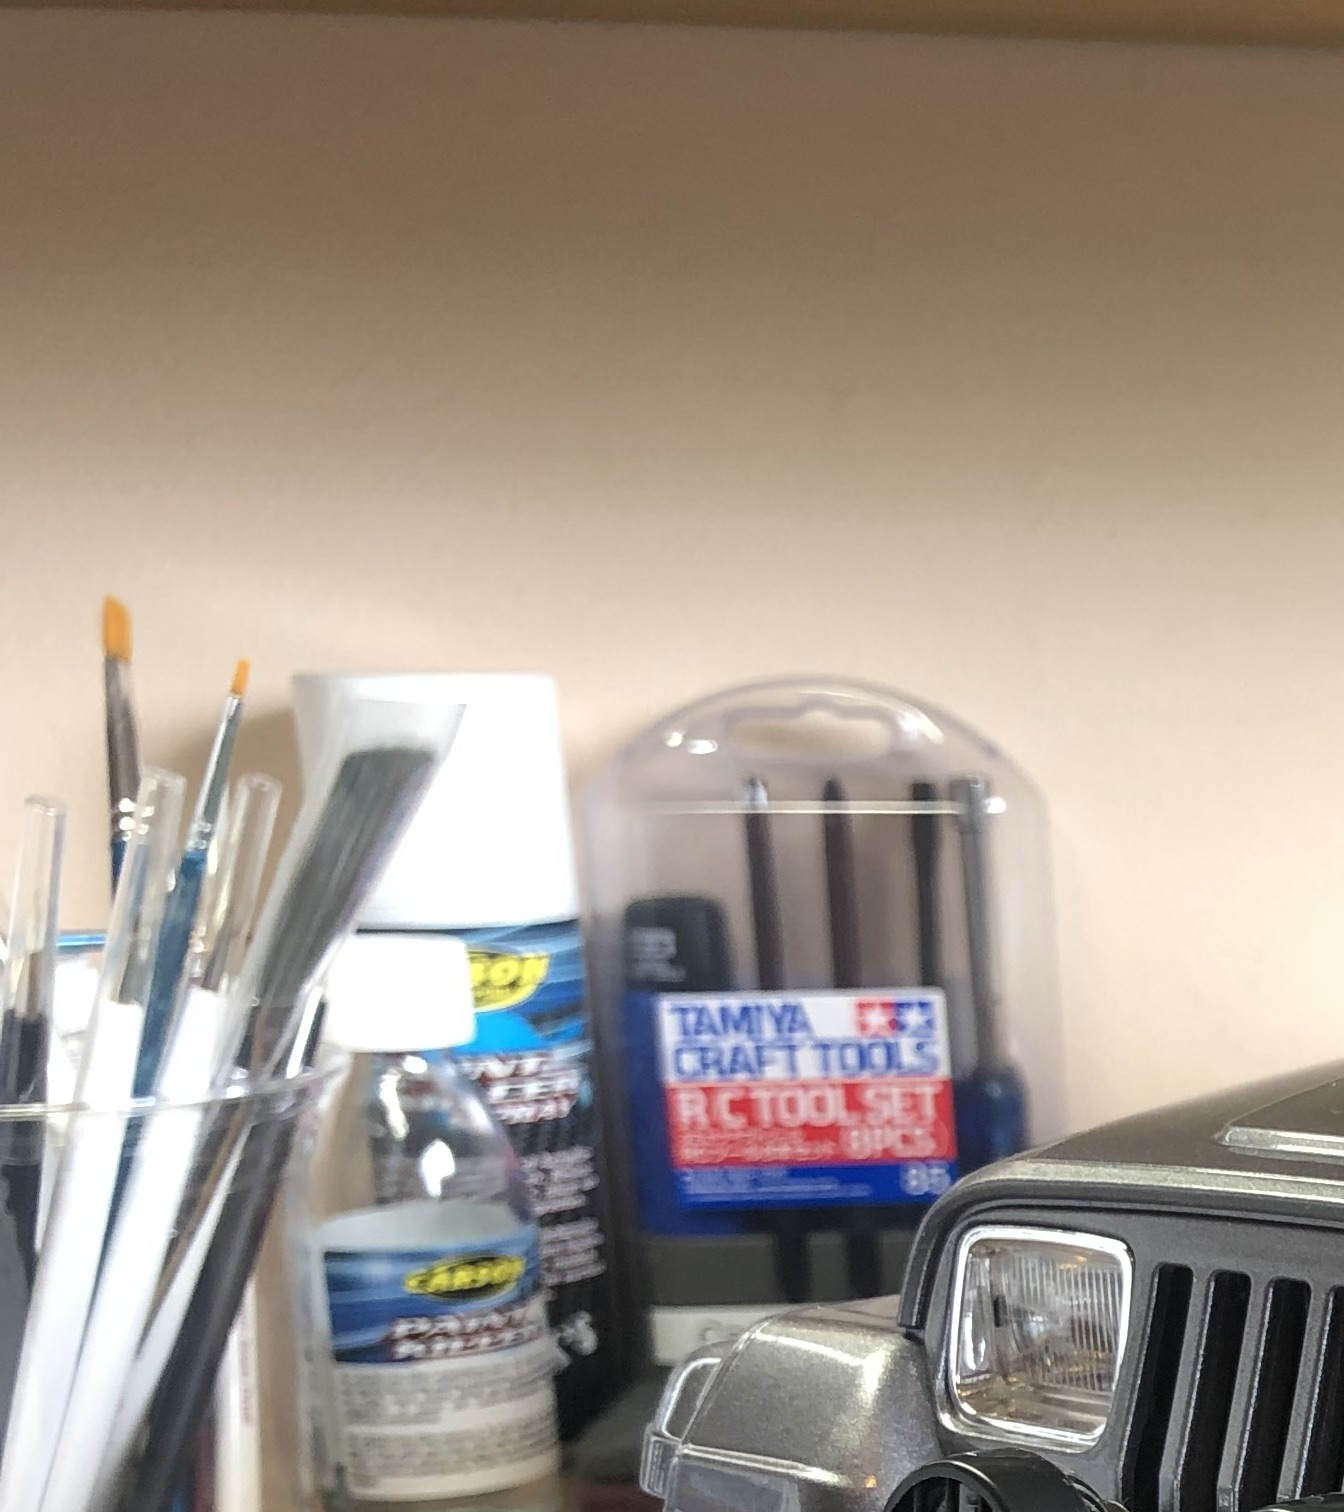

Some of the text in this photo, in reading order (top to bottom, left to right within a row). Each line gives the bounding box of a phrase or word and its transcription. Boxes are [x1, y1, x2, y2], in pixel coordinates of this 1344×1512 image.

[671, 1003, 814, 1036] TAMIYA
[675, 1040, 938, 1077] CRAFT TOOLS
[750, 1087, 860, 1127] TOOL
[861, 1084, 943, 1125] SET
